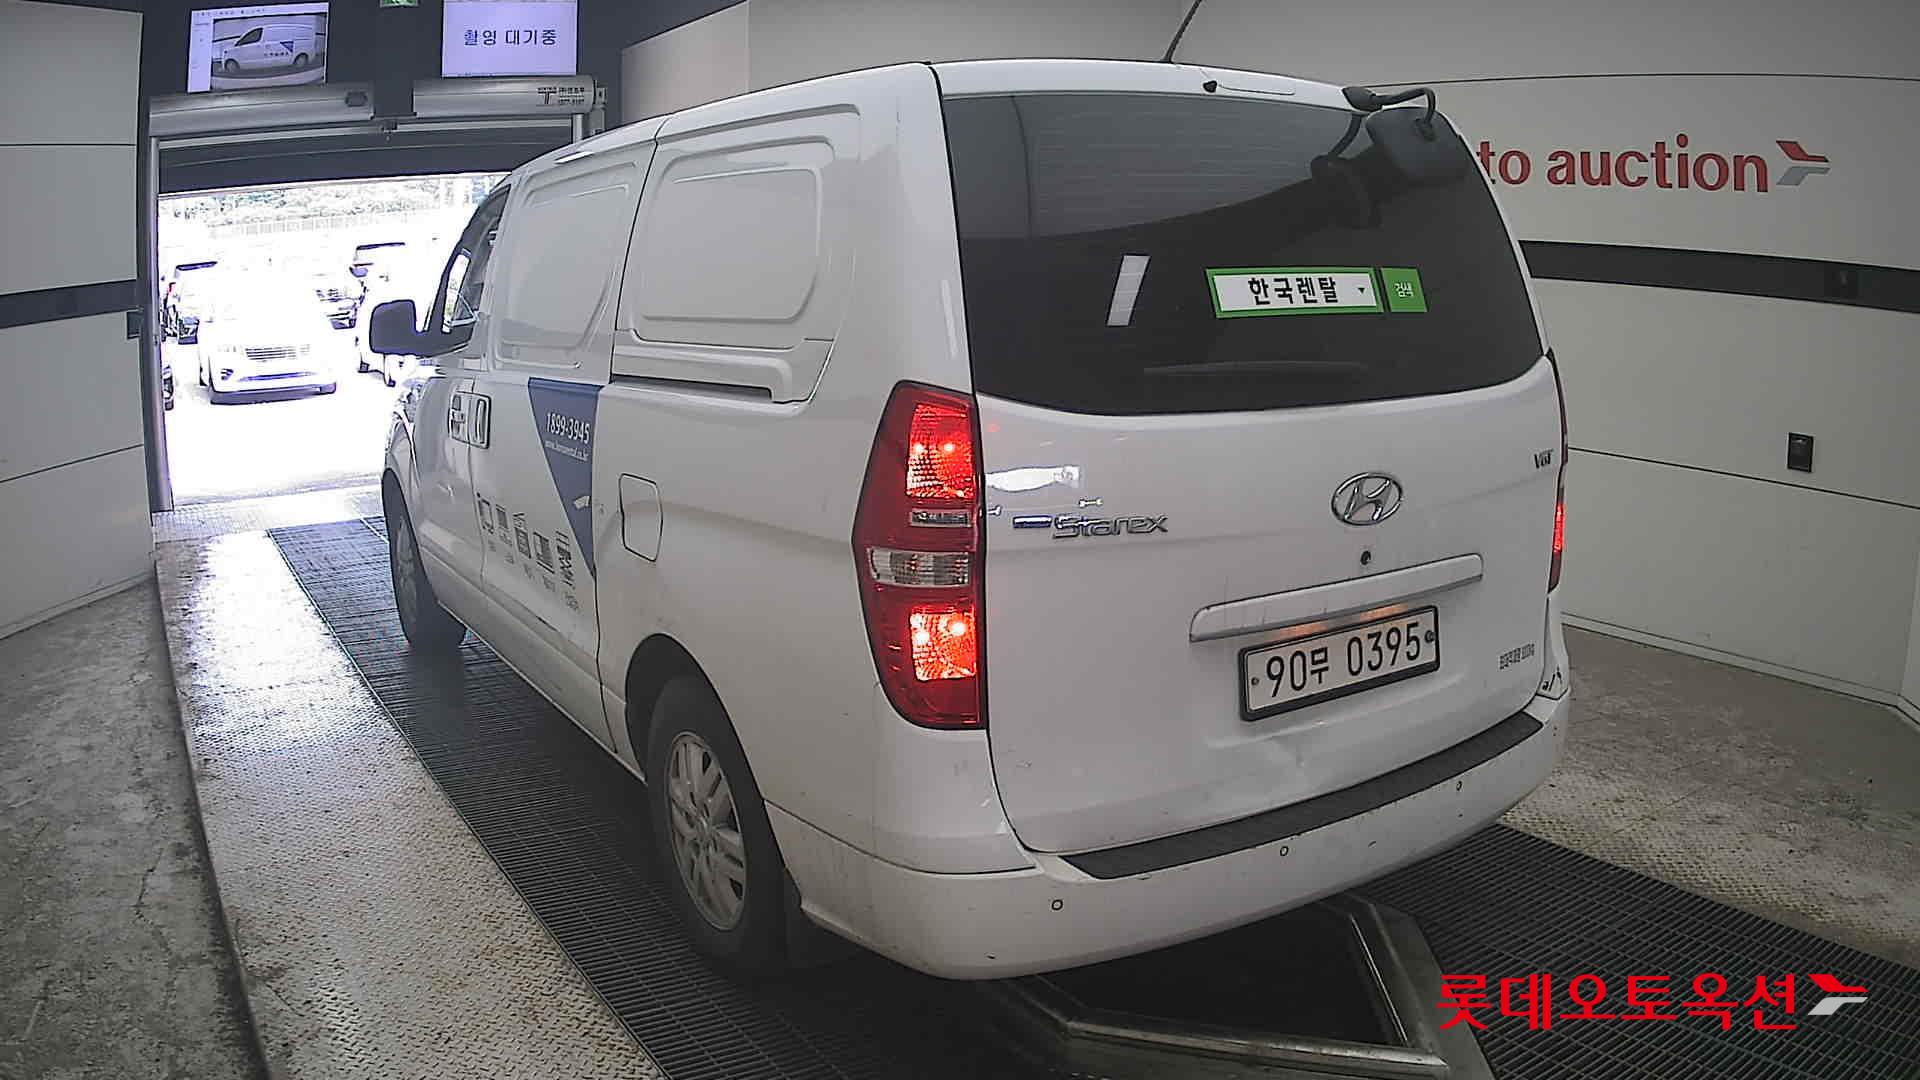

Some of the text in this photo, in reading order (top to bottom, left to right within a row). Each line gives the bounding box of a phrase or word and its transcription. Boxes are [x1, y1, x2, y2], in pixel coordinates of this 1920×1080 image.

[505, 28, 557, 46] 대기중
[1547, 133, 1769, 193] auction
[1248, 276, 1339, 306] 한국렌탈
[1393, 281, 1414, 298] 검색
[1053, 512, 1168, 540] Starex
[1266, 622, 1421, 698] 90무 0395
